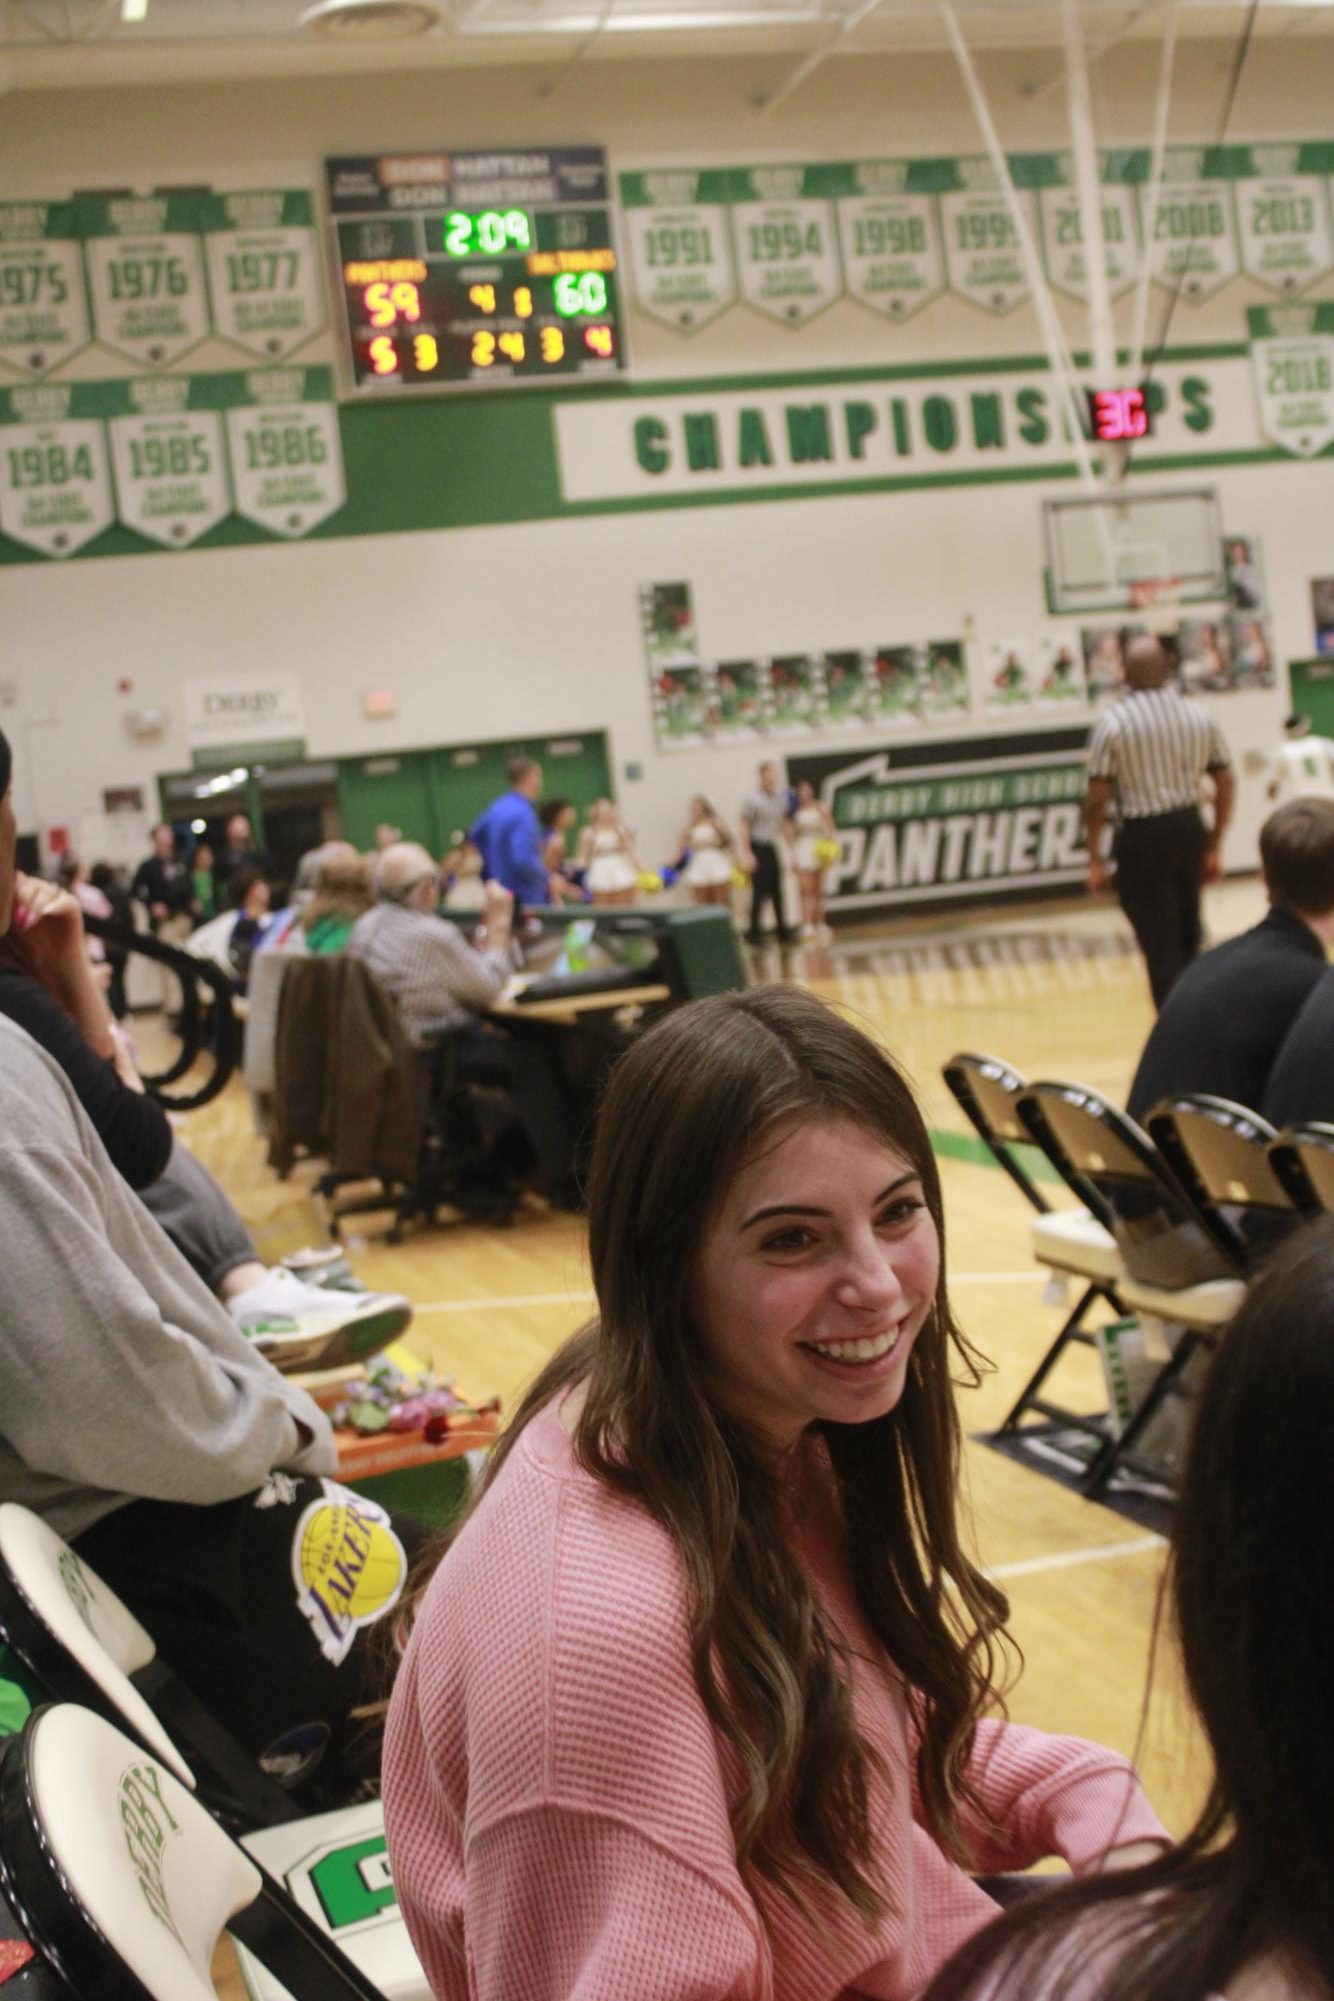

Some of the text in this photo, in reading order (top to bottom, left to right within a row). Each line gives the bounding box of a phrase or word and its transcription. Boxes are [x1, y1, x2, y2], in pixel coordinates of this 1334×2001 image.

[855, 214, 927, 257] 1998
[1252, 197, 1314, 235] 2013
[644, 227, 714, 267] 1991
[749, 221, 823, 262] 1994
[0, 263, 68, 304] 975
[107, 257, 189, 300] 1976
[225, 250, 300, 294] 1977
[364, 281, 421, 328] 59
[469, 284, 496, 314] 4
[553, 271, 608, 316] 60
[369, 335, 398, 375] 5
[414, 334, 439, 372] 3
[540, 326, 565, 363] 3
[585, 325, 613, 358] 4
[1268, 355, 1331, 395] 2018
[7, 442, 95, 489] 1984
[129, 433, 211, 479] 1985
[244, 424, 328, 469] 1986
[1014, 767, 1087, 801] SCHO
[823, 801, 1092, 895] PANTHER
[307, 1498, 383, 1644] LAKER
